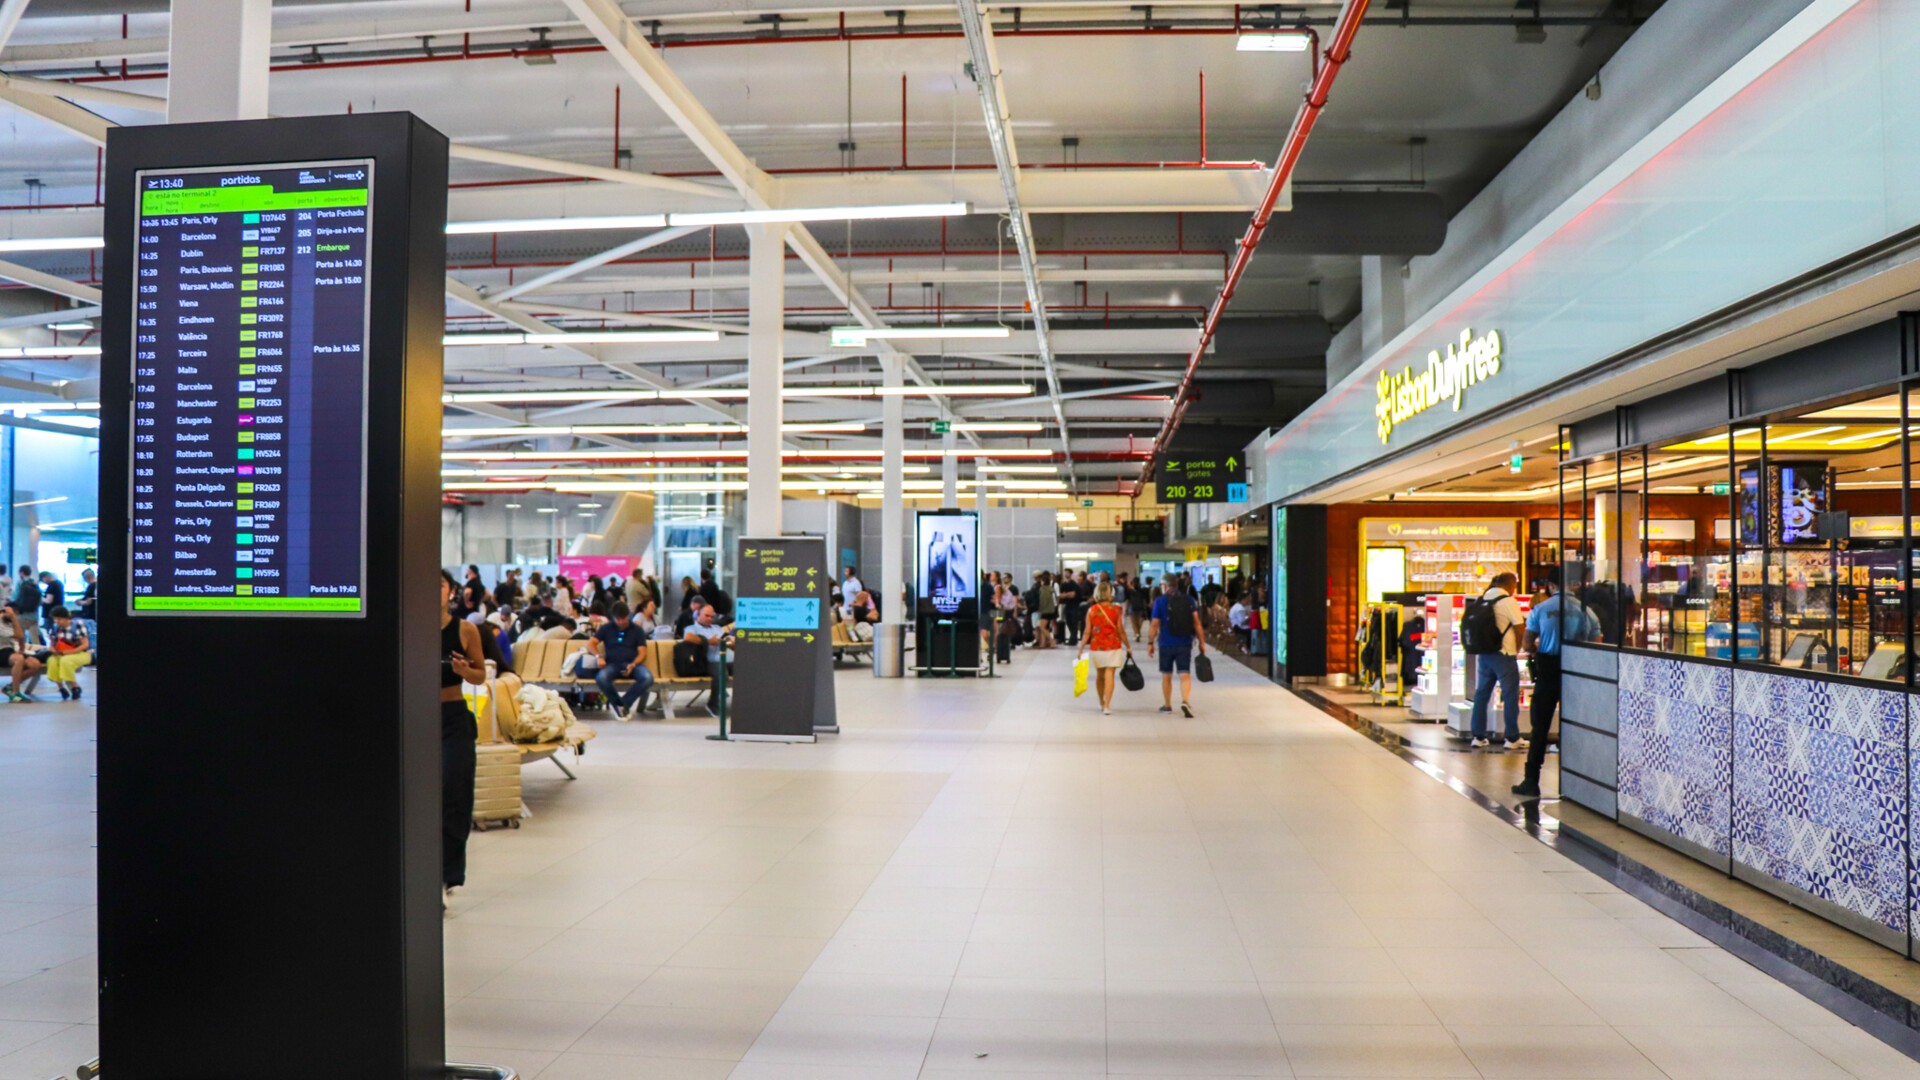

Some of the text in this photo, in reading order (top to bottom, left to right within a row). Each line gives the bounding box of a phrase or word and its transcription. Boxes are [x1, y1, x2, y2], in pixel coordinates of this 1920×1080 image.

[160, 178, 184, 188] 13:40
[221, 174, 261, 186] partidas
[182, 190, 210, 198] terminal
[201, 216, 218, 224] Orly
[298, 229, 311, 237] 205
[1391, 328, 1501, 424] LisbonDutyFree
[177, 416, 212, 426] Estugarda
[177, 434, 209, 442] Budapest
[1186, 461, 1216, 469] portas
[197, 484, 225, 493] Delgada
[1166, 486, 1213, 497] 210 213
[196, 518, 211, 526] Orly
[1439, 526, 1489, 535] PORTUGAL
[196, 534, 211, 543] Orly
[765, 568, 798, 576] 201-207
[765, 582, 795, 591] 210-213
